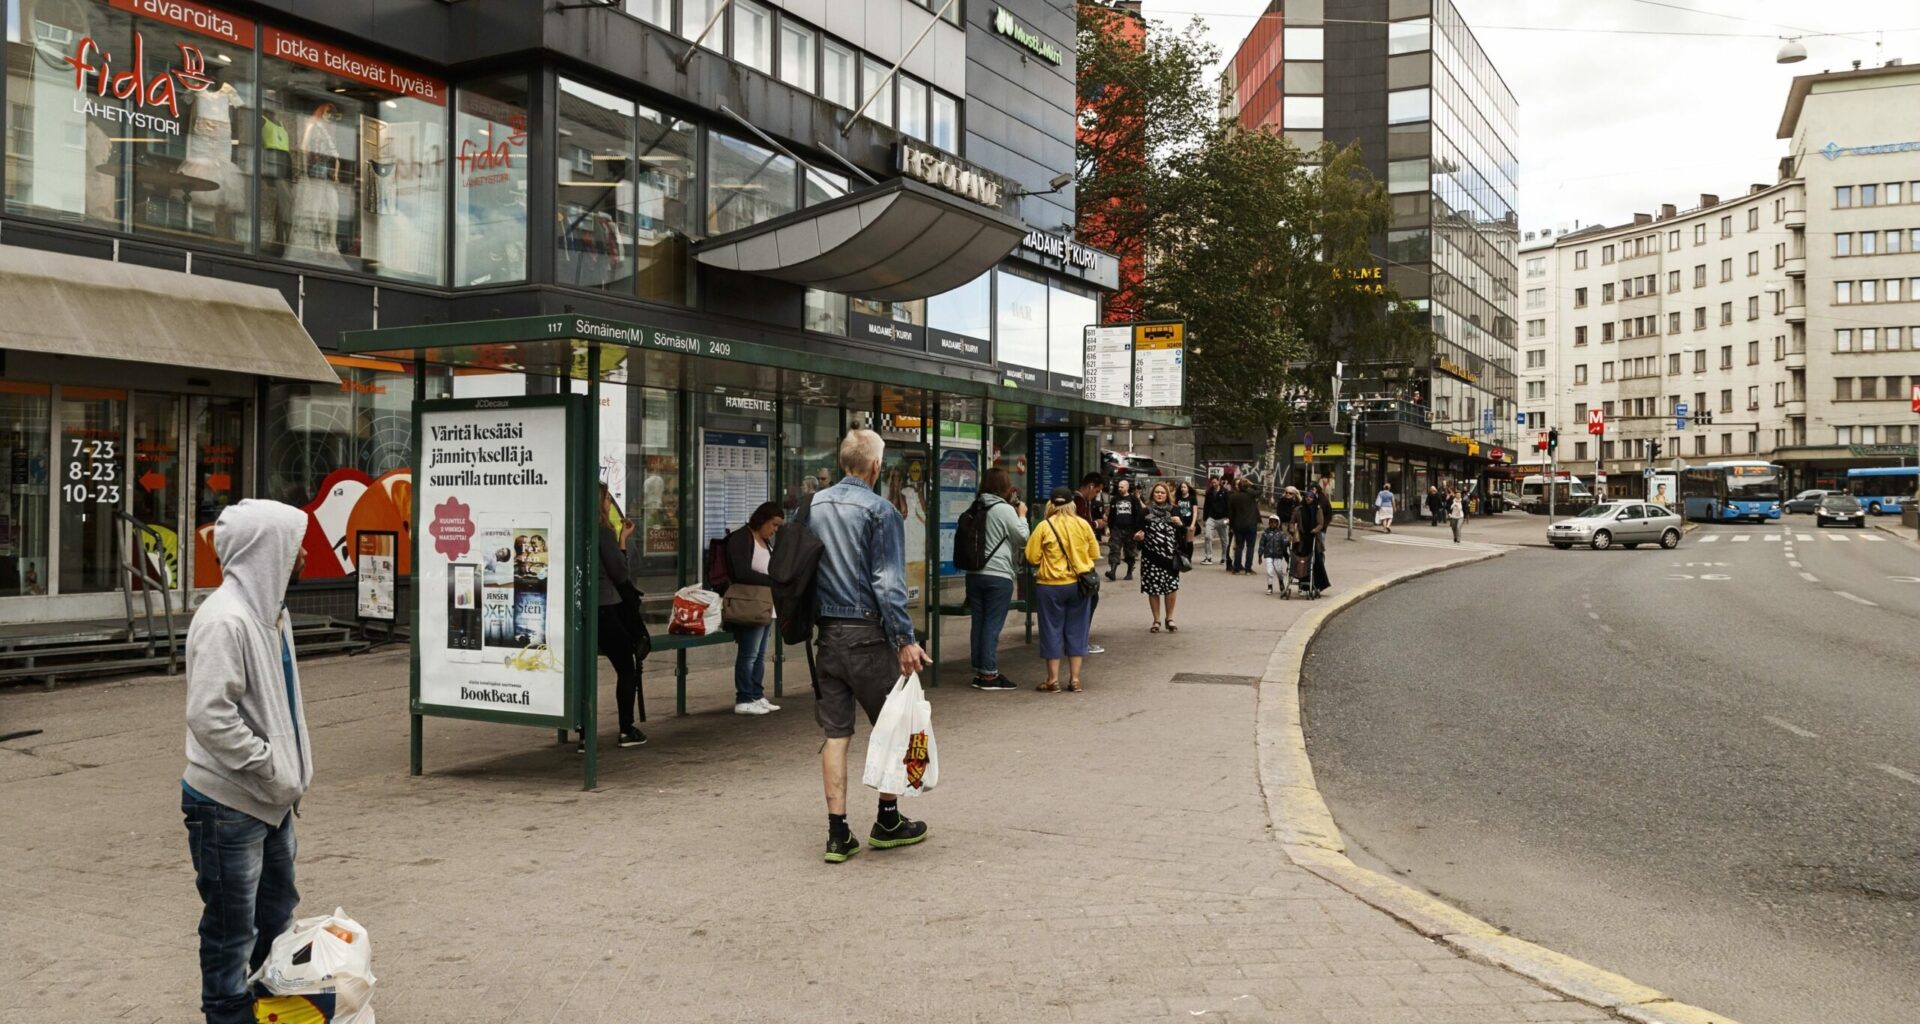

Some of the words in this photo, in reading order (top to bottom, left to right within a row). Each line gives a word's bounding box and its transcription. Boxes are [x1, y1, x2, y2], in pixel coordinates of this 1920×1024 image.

[64, 31, 179, 118] fida
[275, 33, 319, 64] jotka
[324, 51, 386, 83] tekevät
[390, 69, 437, 99] hyvää.
[73, 97, 180, 136] LÄHETYSTORI
[455, 120, 511, 174] fida
[1023, 231, 1064, 259] MADAME
[1072, 246, 1099, 271] KURVI
[547, 323, 563, 333] 117
[576, 320, 644, 345] Sörnäinen(M)
[654, 333, 701, 354] Sörnäs(M)
[709, 342, 732, 356] 2409
[868, 323, 892, 338] MADAME
[896, 330, 913, 342] KURVI
[941, 338, 961, 351] MADAME
[1589, 411, 1603, 424] M
[431, 424, 472, 442] Väritä
[474, 422, 523, 440] kesääsi
[71, 439, 115, 459] 7-23
[429, 446, 517, 468] jännityksellä
[517, 446, 533, 467] ja
[69, 462, 115, 481] 8-23
[429, 470, 481, 488] suurilla
[483, 468, 548, 486] tunteilla.
[63, 484, 120, 503] 10-23
[461, 686, 530, 705] BookBeat.fi
